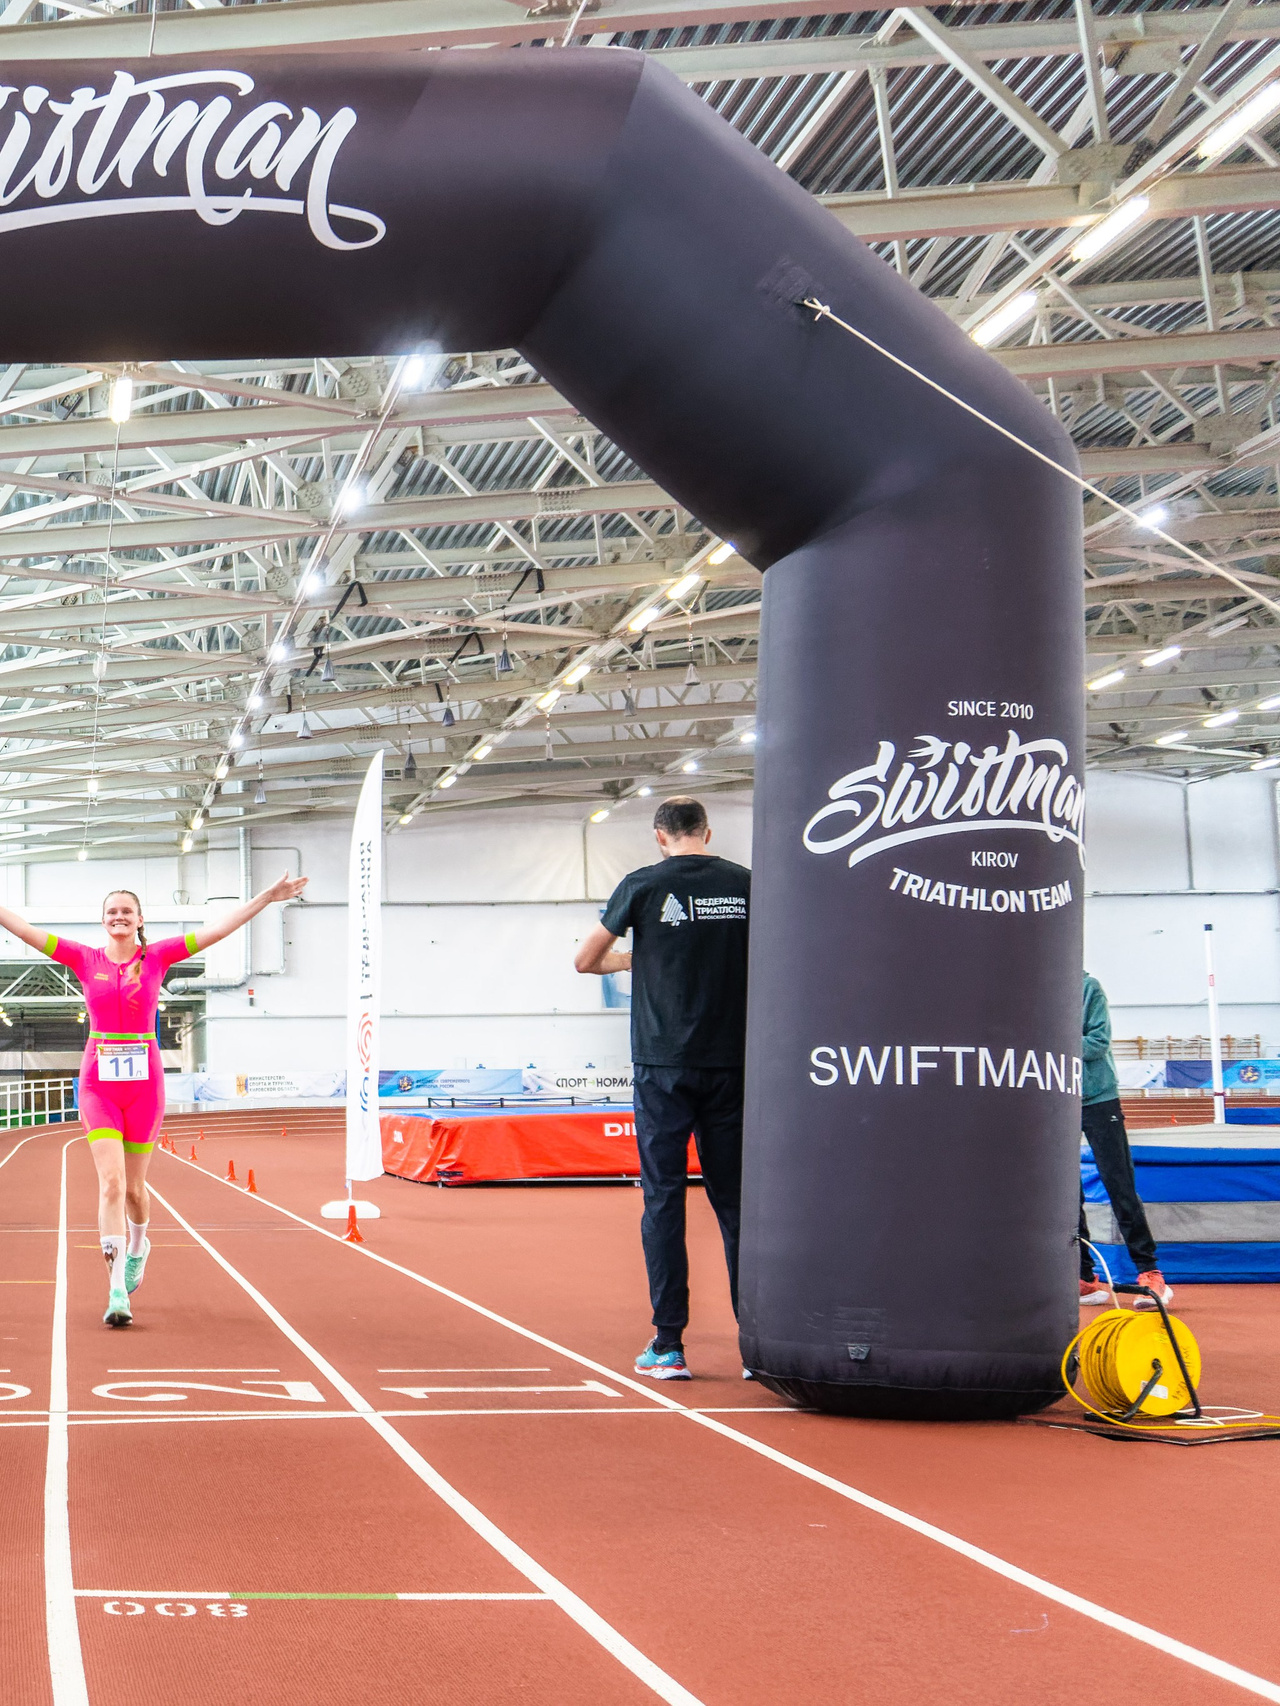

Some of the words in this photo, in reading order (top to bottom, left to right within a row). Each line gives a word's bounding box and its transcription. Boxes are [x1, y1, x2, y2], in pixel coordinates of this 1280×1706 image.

[947, 700, 996, 717] SINCE
[1000, 702, 1034, 720] 2010
[971, 851, 1019, 868] KIROV
[889, 867, 1026, 913] TRIATHLON
[1028, 880, 1073, 913] TEAM
[695, 896, 746, 906] ФЕДЕРАЦИЯ
[695, 905, 747, 915] ТРИАТЛОНА
[109, 1057, 134, 1077] 11
[555, 1077, 588, 1088] СПОРТ
[91, 1381, 327, 1403] 2
[380, 1379, 625, 1399] 1
